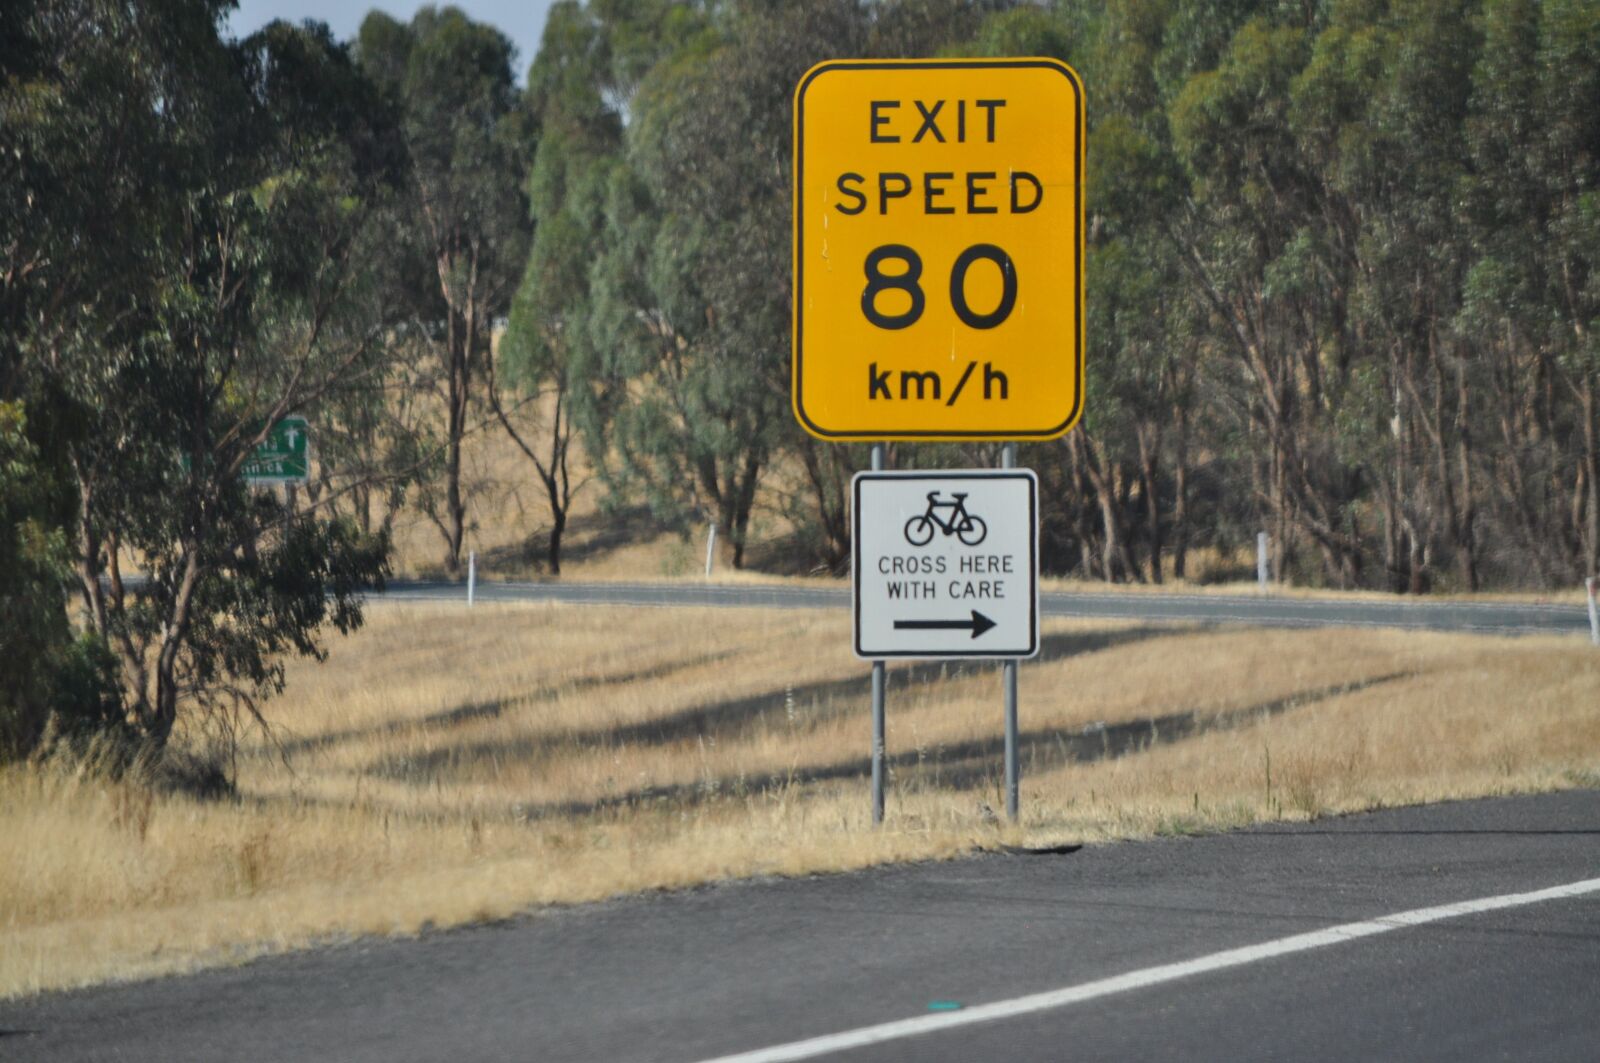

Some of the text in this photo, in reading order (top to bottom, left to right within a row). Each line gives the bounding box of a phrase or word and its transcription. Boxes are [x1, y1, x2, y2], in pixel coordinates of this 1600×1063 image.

[870, 99, 1007, 144] EXIT
[834, 171, 1044, 216] SPEED
[860, 243, 1018, 331] 80
[868, 361, 1009, 407] km/h
[878, 554, 1014, 575] CROSS HERE
[887, 580, 1005, 600] WITH CARE
